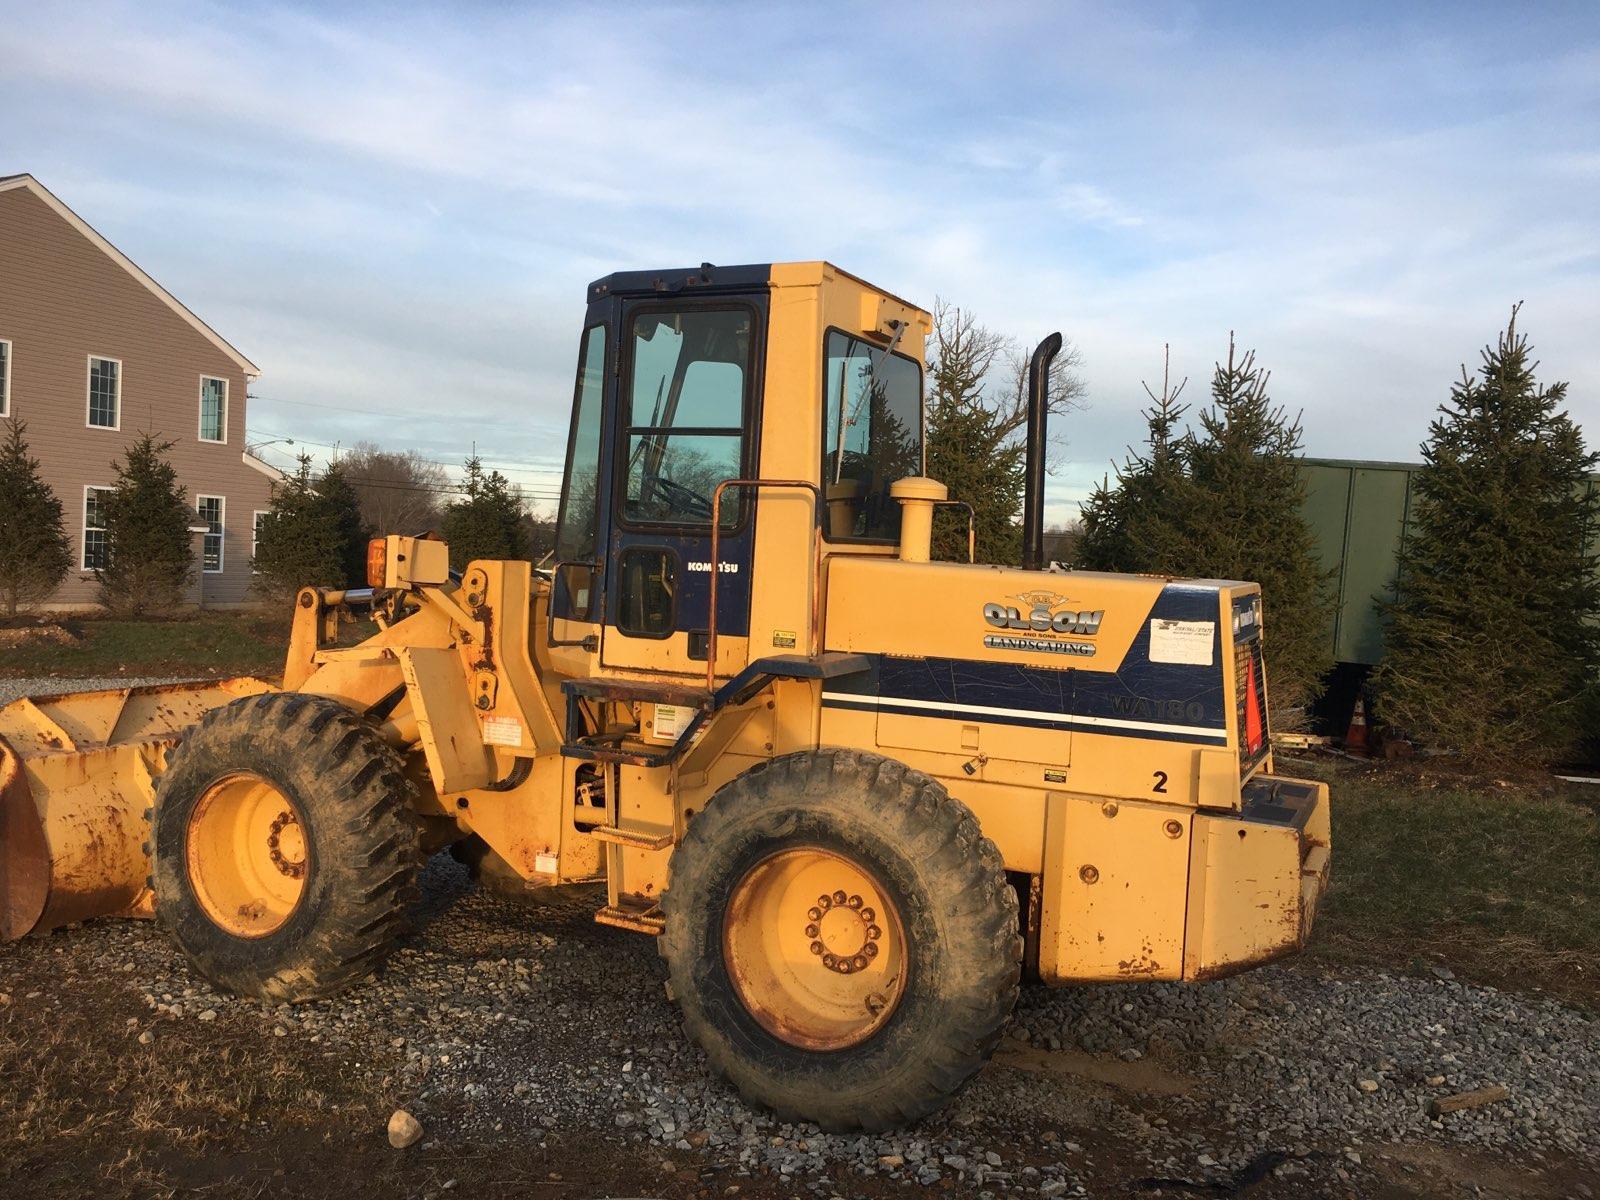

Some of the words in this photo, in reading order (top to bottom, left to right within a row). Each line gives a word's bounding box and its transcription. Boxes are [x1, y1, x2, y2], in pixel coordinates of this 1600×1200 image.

[687, 561, 739, 573] KOMTSU
[983, 602, 1105, 635] OLSON
[990, 637, 1089, 655] LANDSCAPING
[1106, 693, 1205, 721] WA180
[1152, 771, 1169, 793] 2
